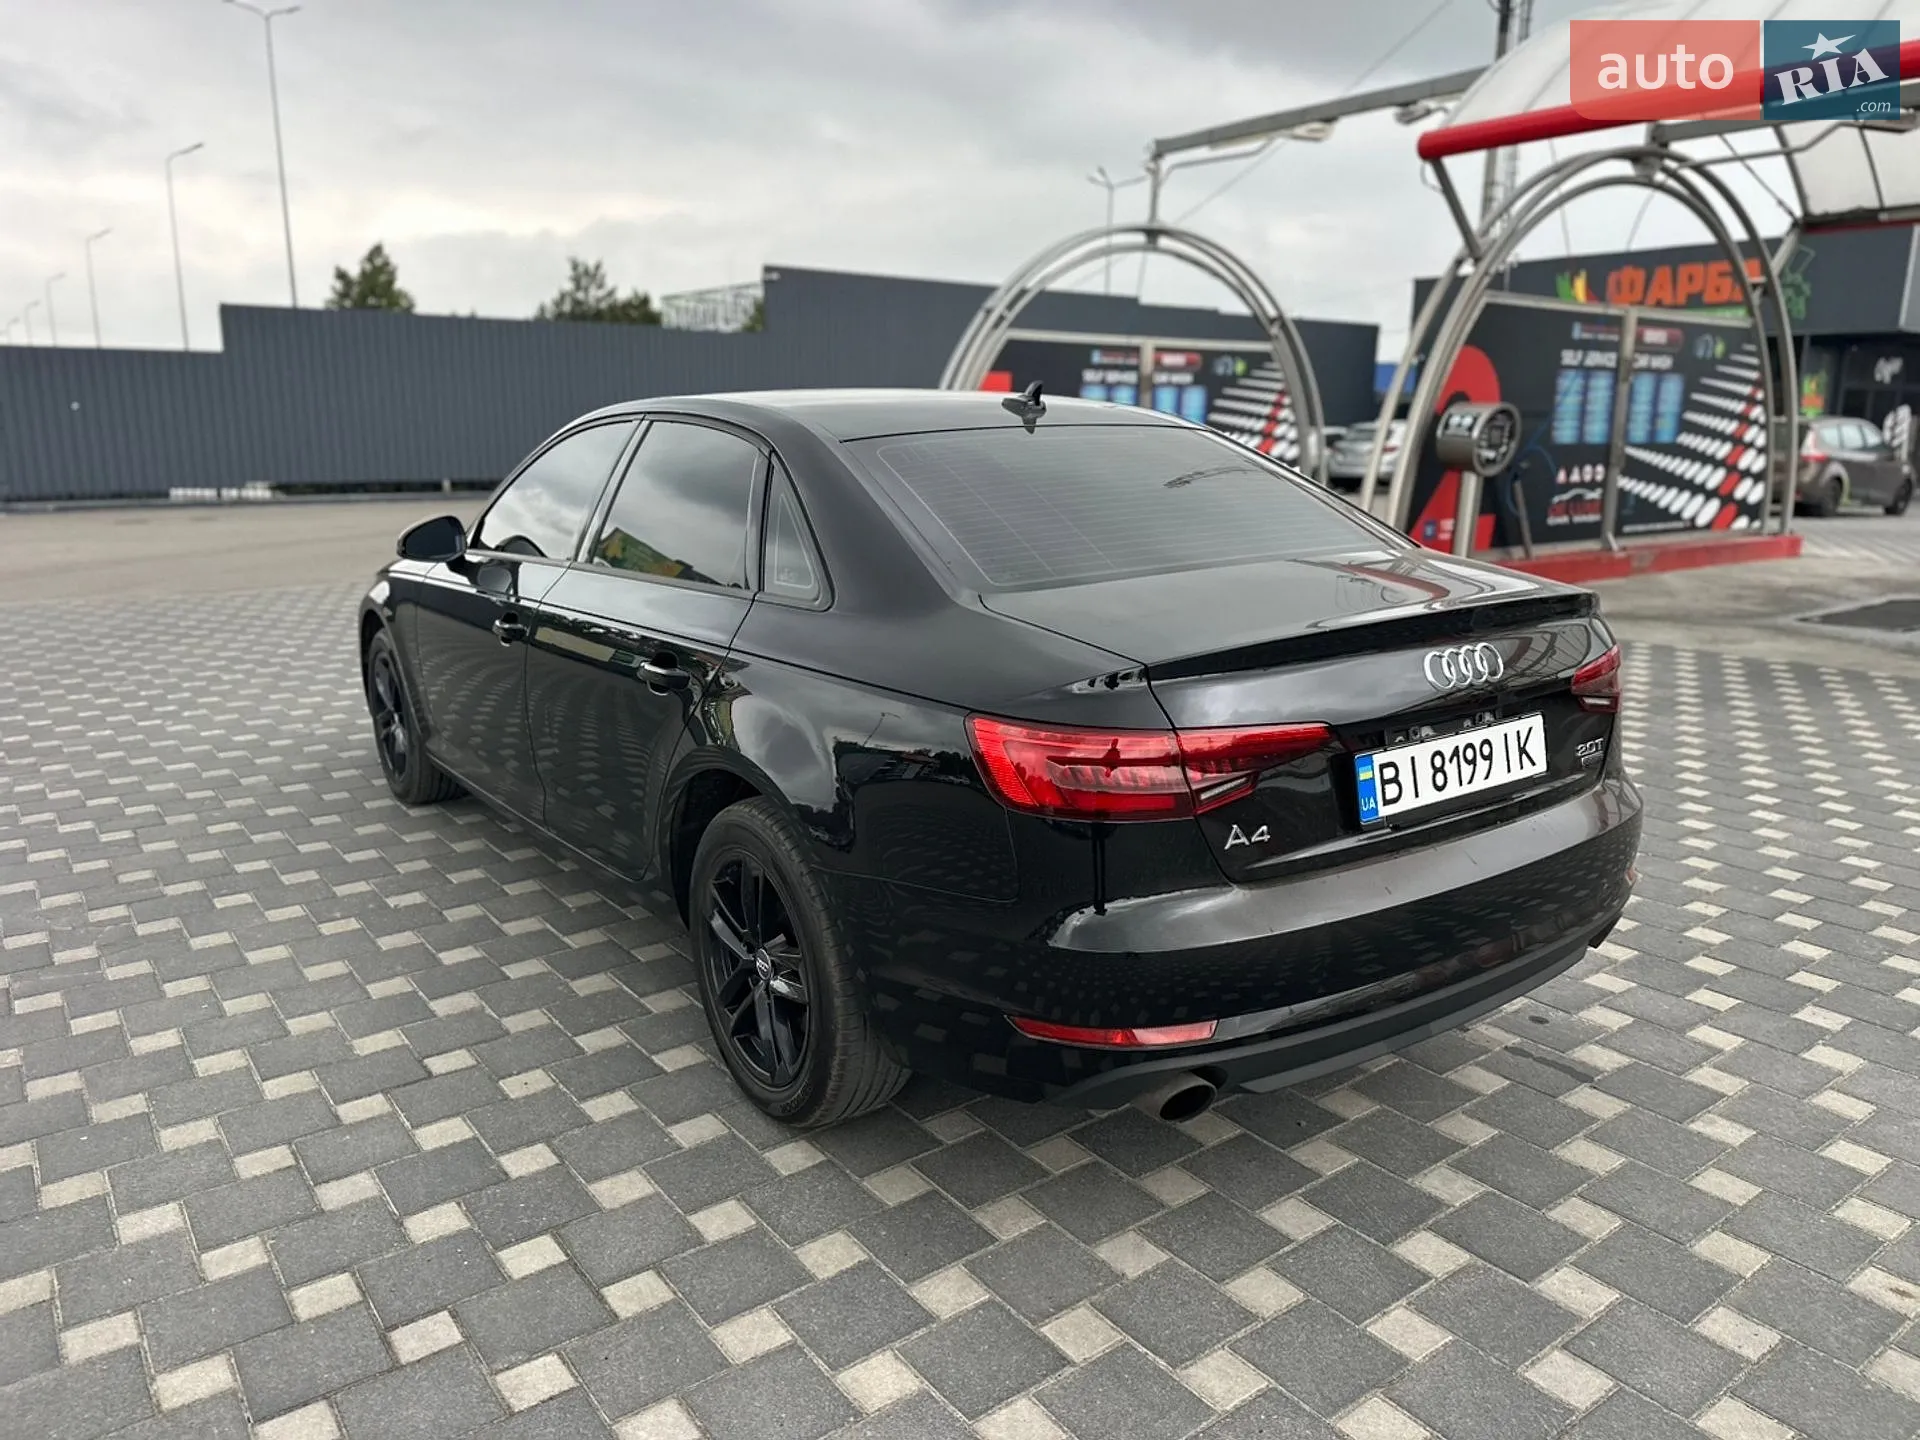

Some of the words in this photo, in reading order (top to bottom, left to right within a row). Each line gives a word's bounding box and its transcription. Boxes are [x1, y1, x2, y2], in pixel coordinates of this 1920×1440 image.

[1379, 758, 1420, 806] BI
[1430, 738, 1492, 792] 8199
[1503, 726, 1536, 774] IK
[1361, 797, 1377, 812] UA
[1224, 823, 1272, 851] A4
